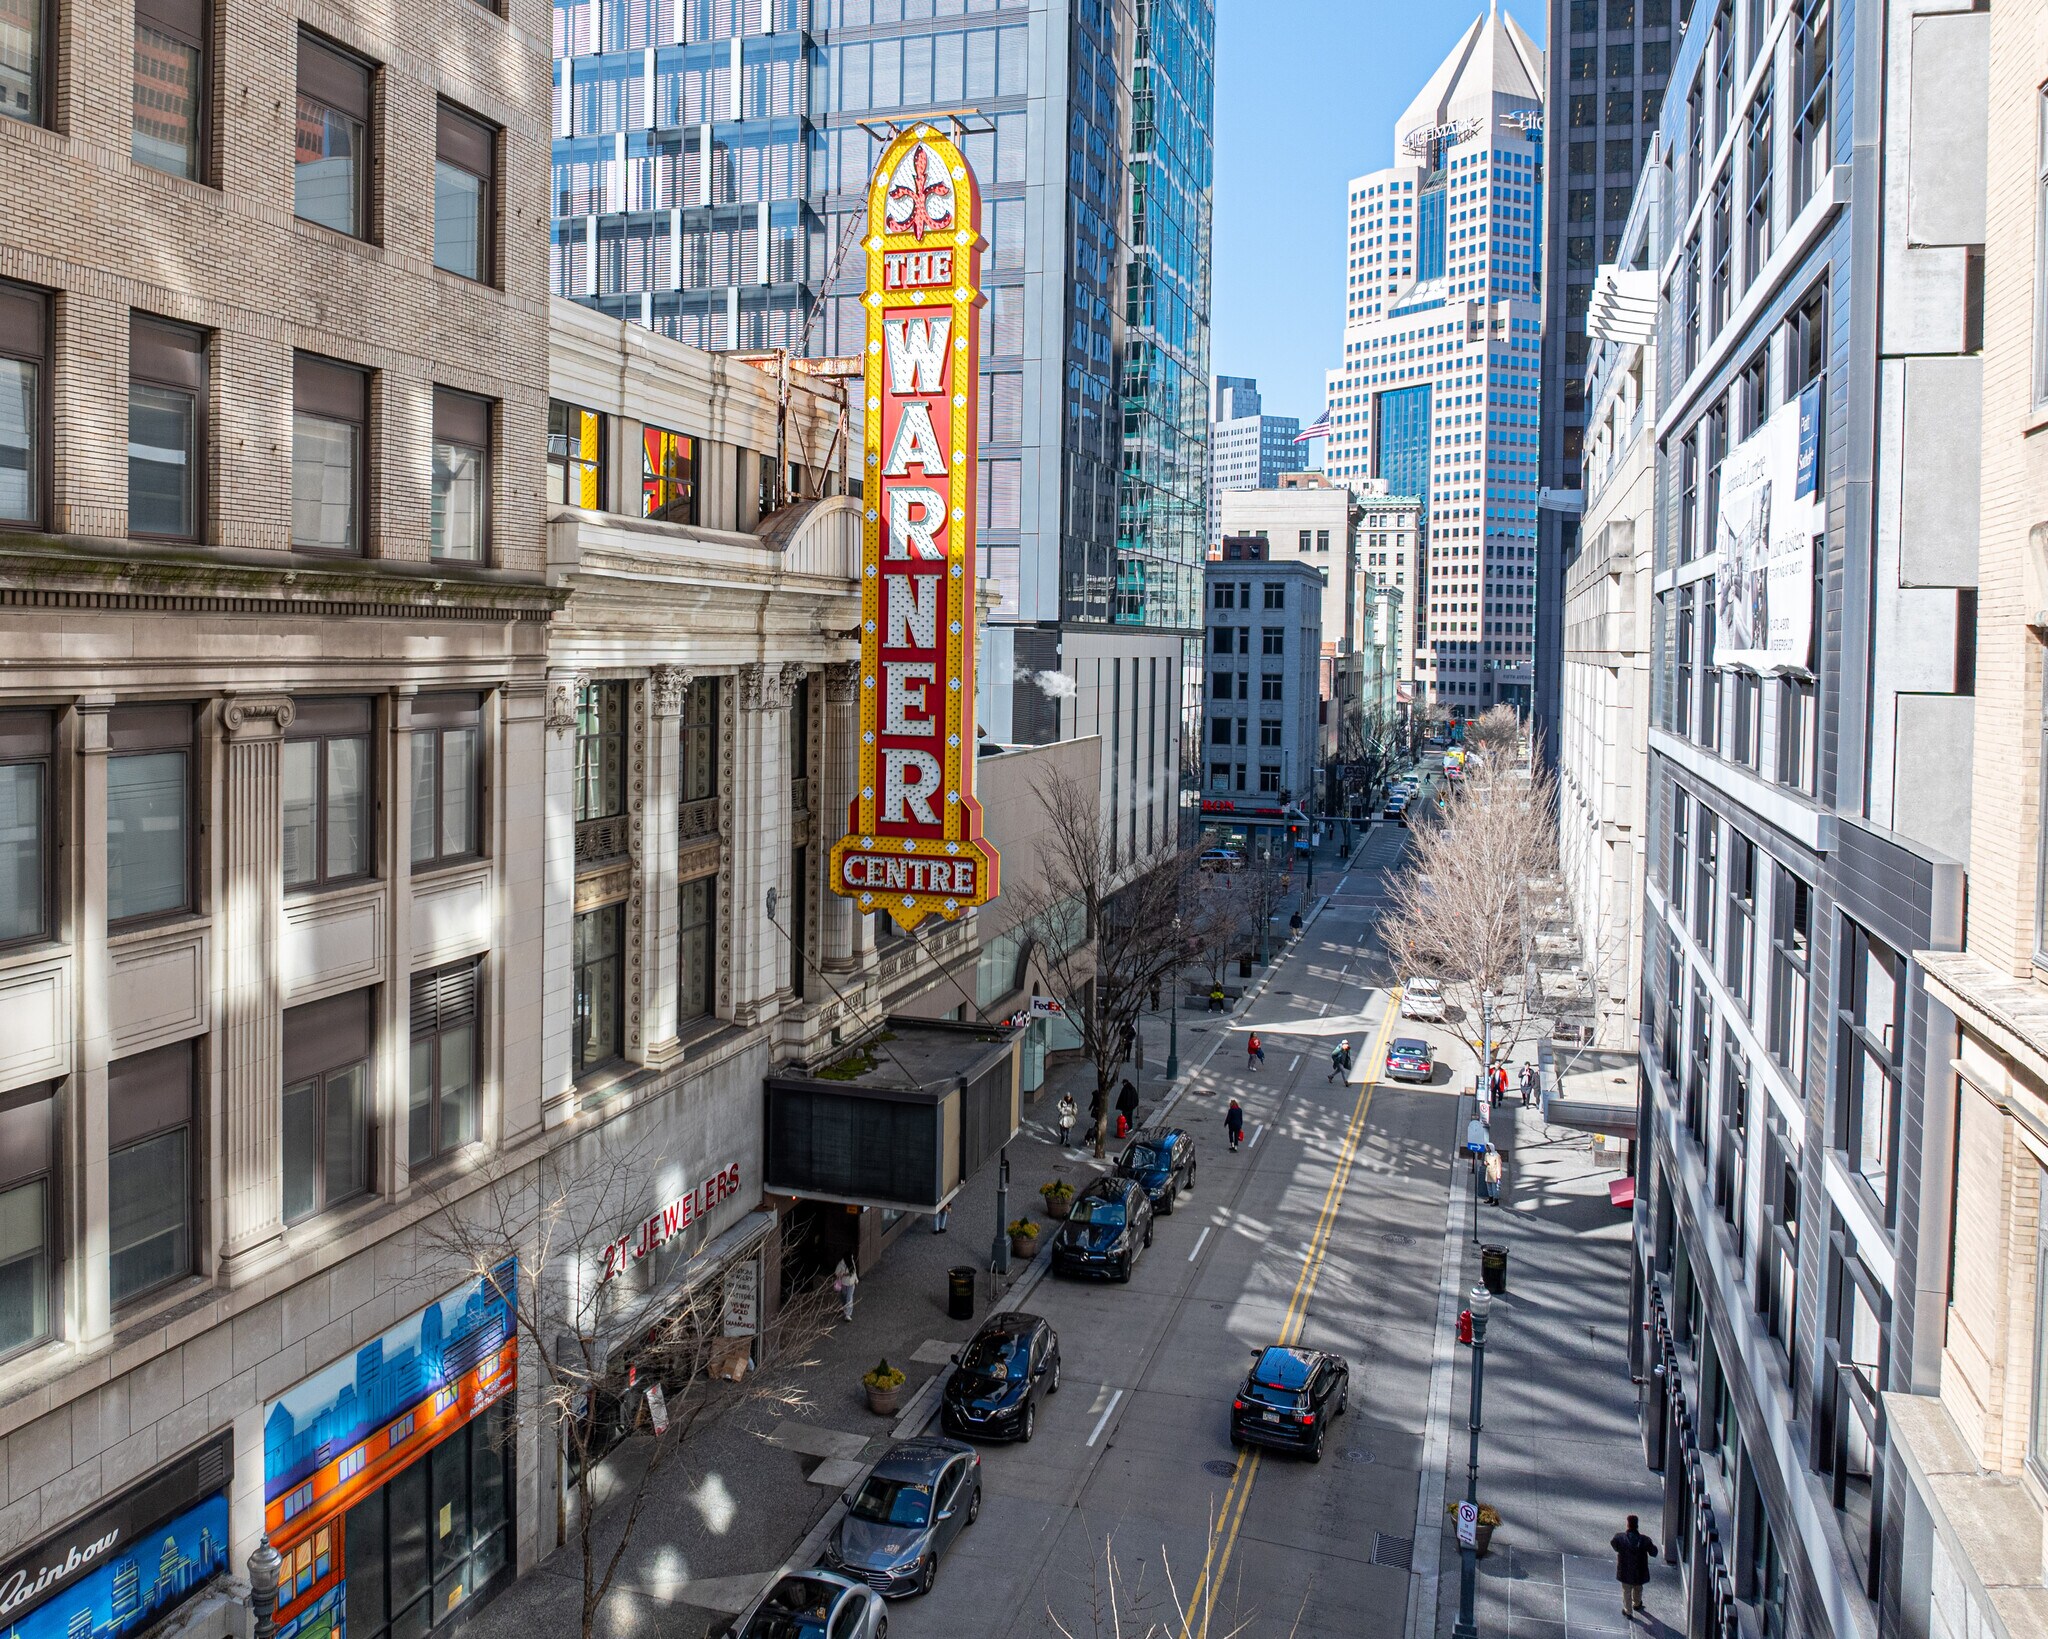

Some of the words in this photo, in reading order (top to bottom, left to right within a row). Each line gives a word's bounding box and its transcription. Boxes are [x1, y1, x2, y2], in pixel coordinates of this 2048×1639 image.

[885, 252, 953, 287] THE
[880, 317, 952, 824] WARNER
[843, 855, 974, 894] CENTRE
[1033, 1000, 1062, 1011] FedEx
[603, 1234, 631, 1282] 2T
[636, 1162, 740, 1259] JEWELERS
[726, 1320, 755, 1330] DIAMONDS
[732, 1308, 749, 1316] GOLD
